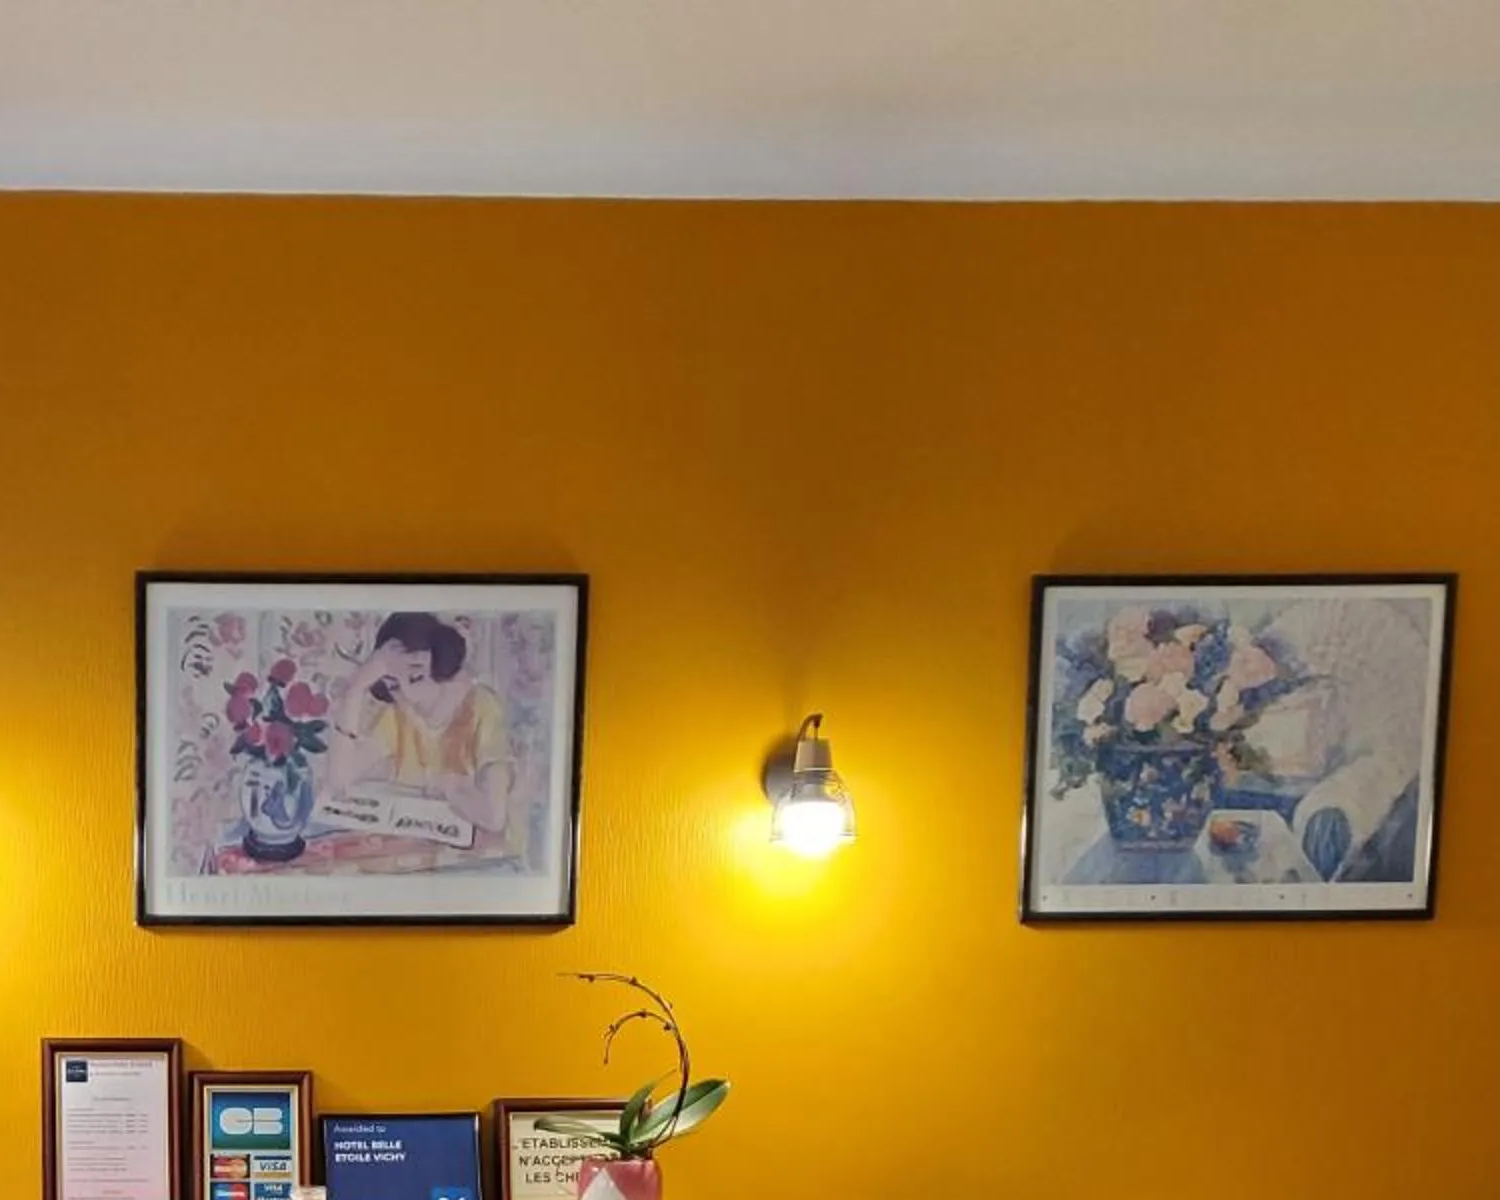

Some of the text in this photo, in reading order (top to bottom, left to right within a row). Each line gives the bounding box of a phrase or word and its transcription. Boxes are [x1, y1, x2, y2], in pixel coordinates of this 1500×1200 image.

[334, 1124, 387, 1133] Awarded to
[334, 1139, 401, 1151] HOTEL BELLE
[335, 1152, 406, 1163] ETOILE VICHY
[259, 1161, 287, 1171] VISA
[525, 1171, 551, 1184] LES
